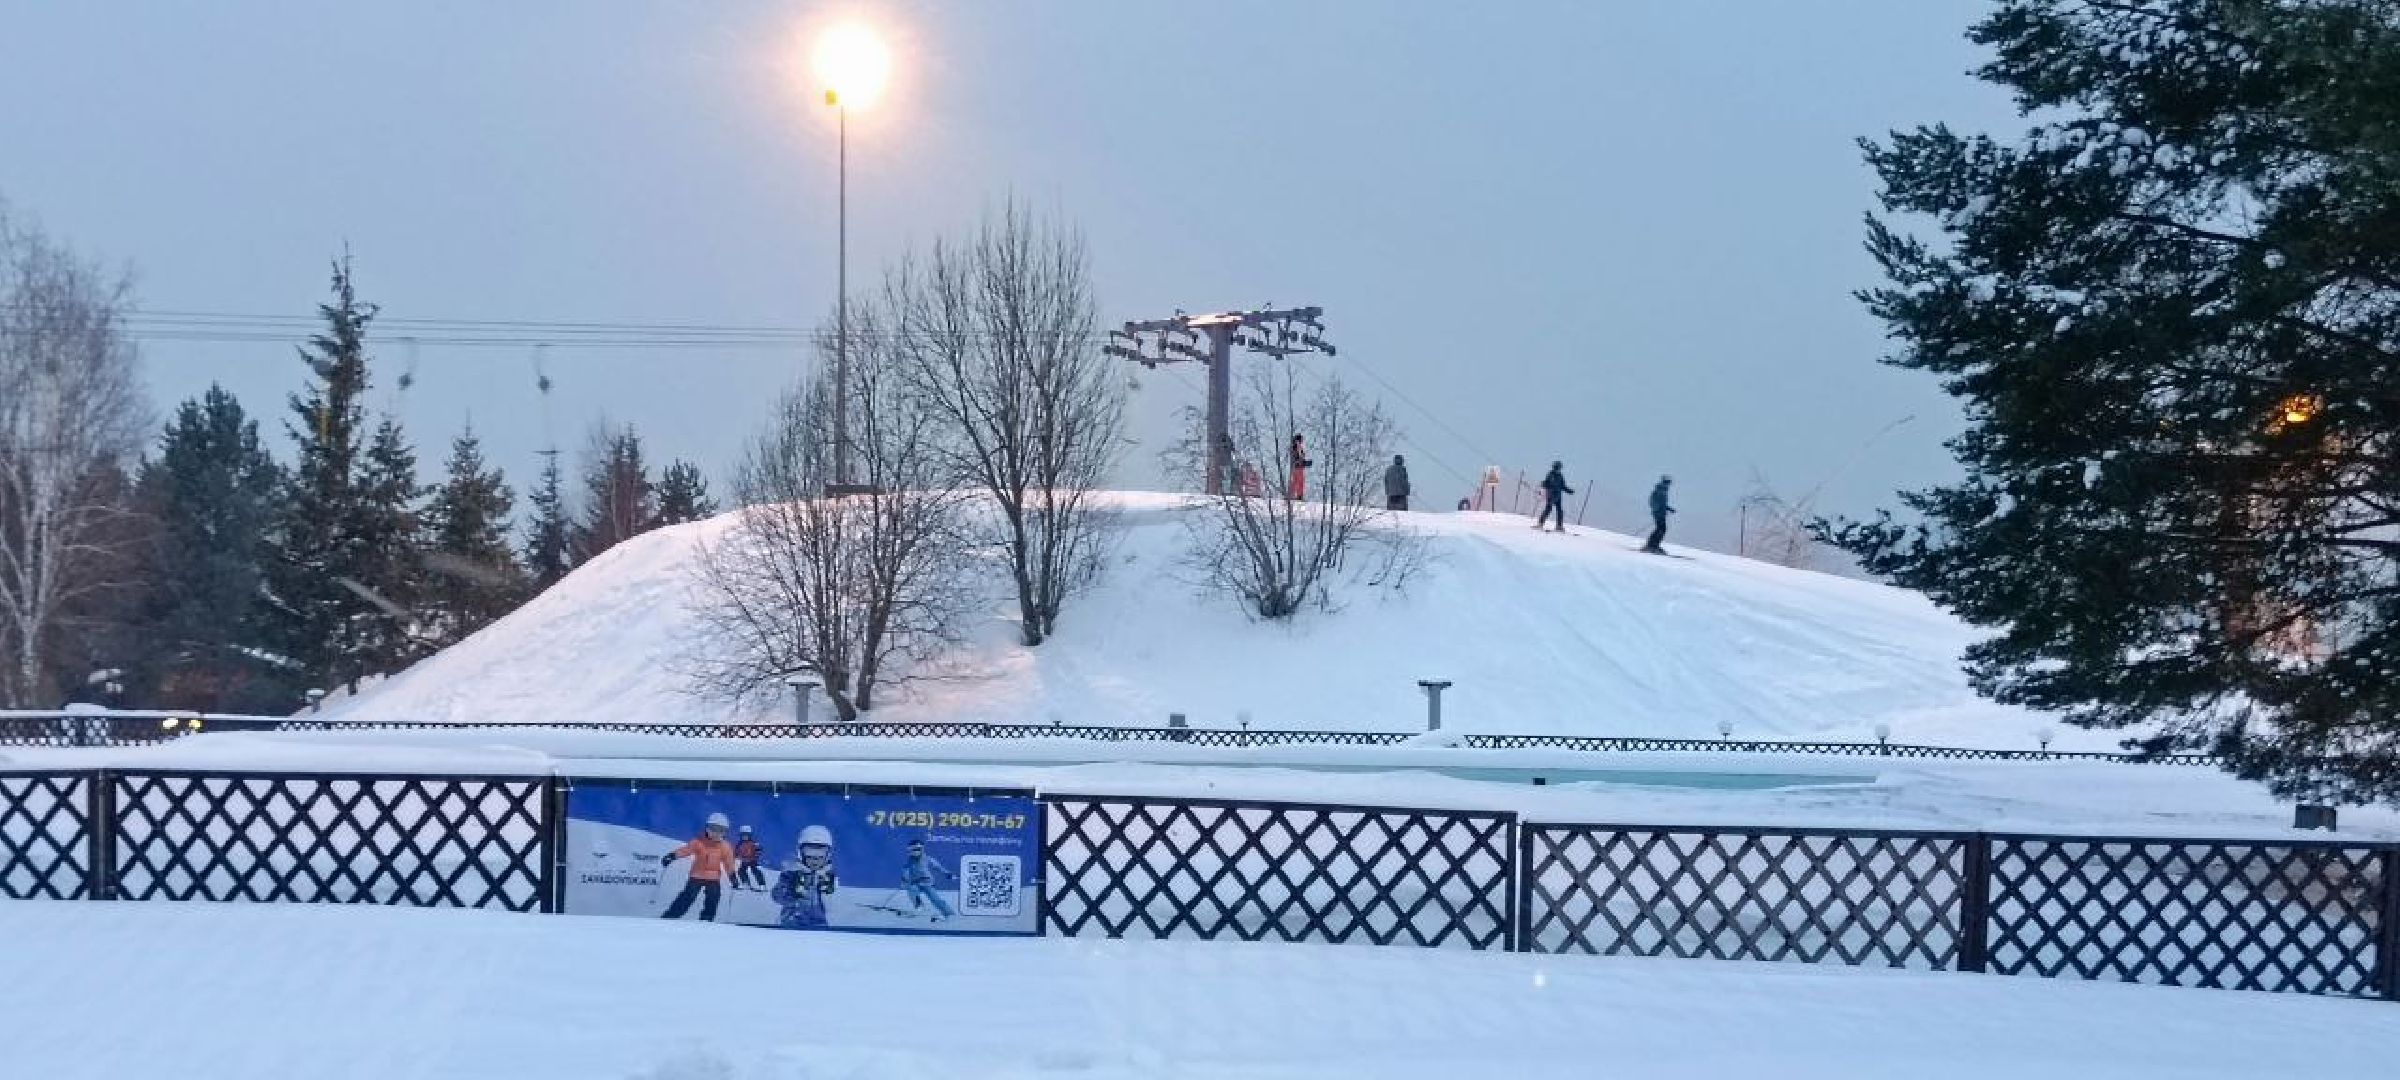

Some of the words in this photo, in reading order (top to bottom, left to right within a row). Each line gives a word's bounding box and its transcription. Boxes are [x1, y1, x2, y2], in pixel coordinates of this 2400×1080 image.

[866, 811, 886, 826] +7
[889, 812, 934, 829] (925)
[938, 812, 1024, 829] 290-71-67
